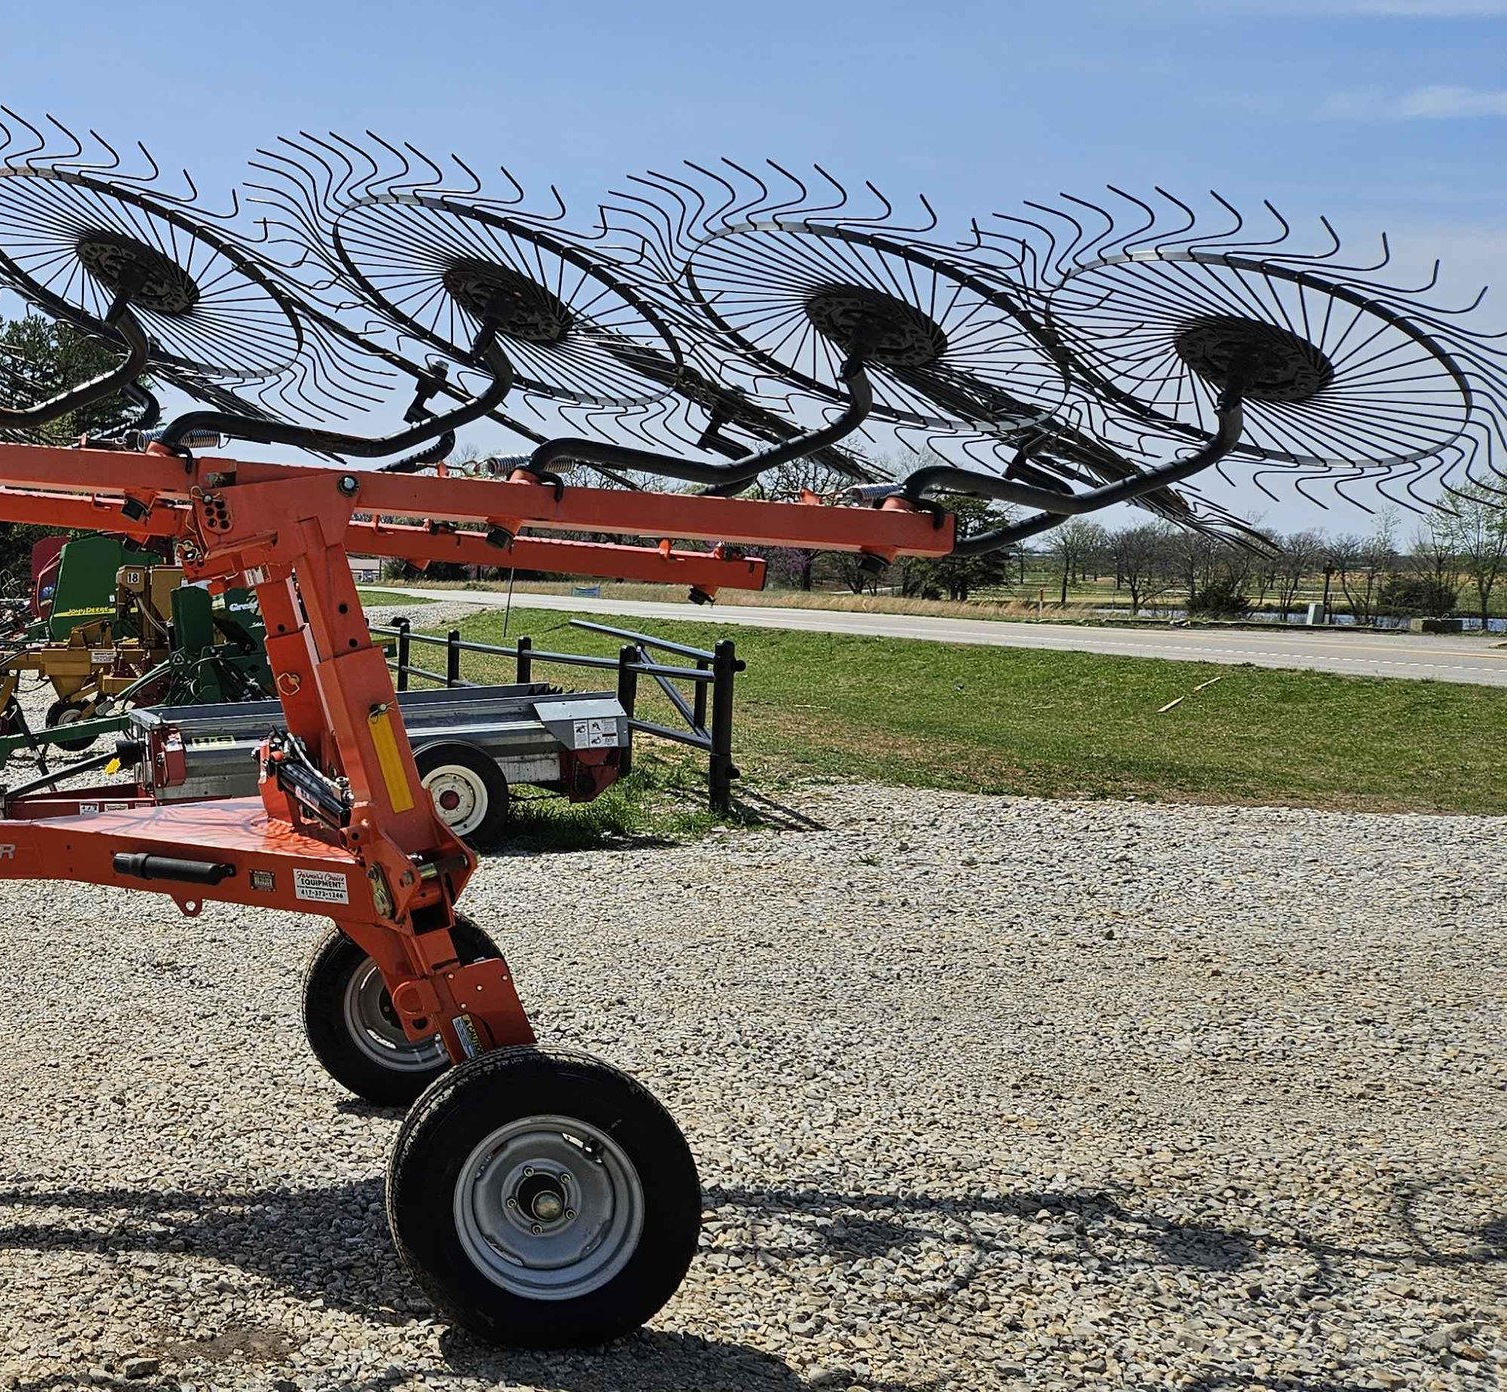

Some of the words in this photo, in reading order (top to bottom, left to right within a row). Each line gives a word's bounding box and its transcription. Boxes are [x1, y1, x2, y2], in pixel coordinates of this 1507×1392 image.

[128, 573, 138, 583] 18
[86, 606, 110, 614] DEERE
[301, 879, 342, 889] EQUIPMENT
